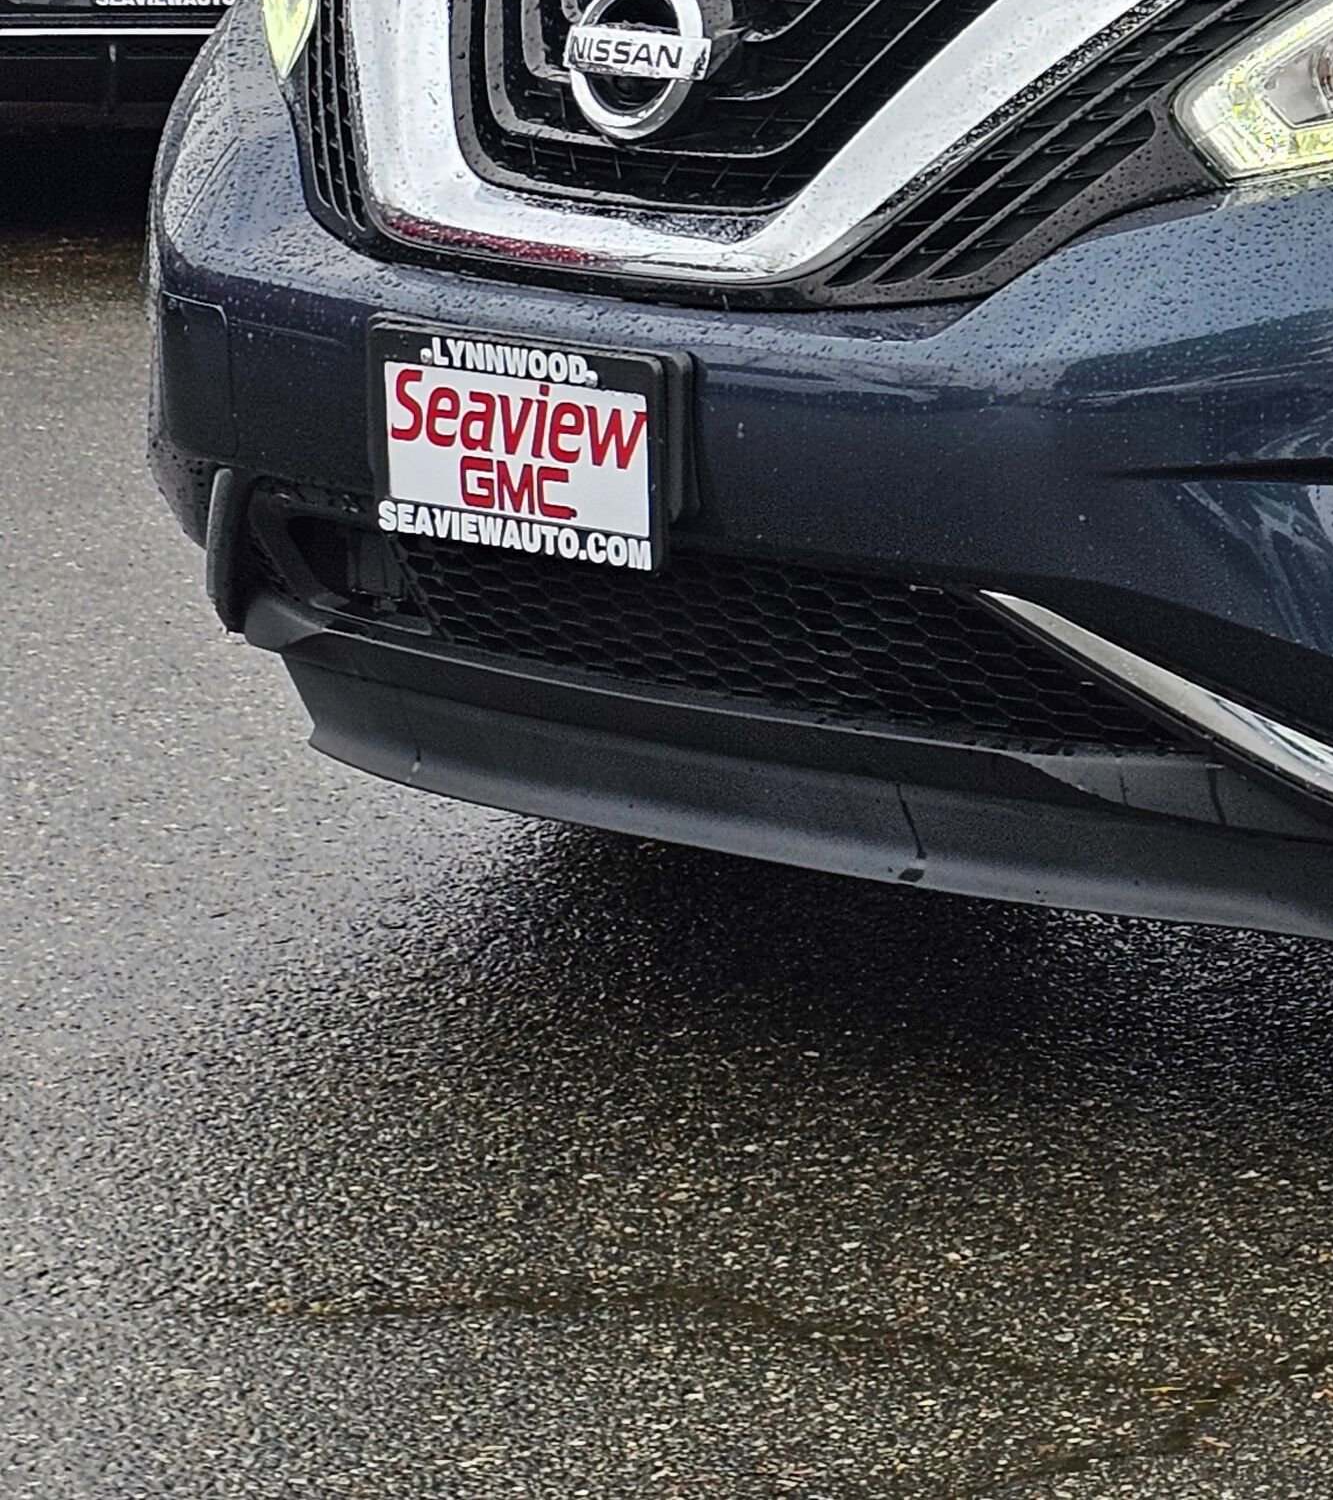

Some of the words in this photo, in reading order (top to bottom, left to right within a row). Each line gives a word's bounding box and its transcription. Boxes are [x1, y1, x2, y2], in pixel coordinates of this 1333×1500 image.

[568, 35, 684, 71] NISSAN
[431, 336, 589, 385] LYNNWOOD
[390, 367, 649, 470] Seaview
[459, 455, 578, 521] GMC
[377, 499, 653, 572] SEAVIEWAUTO.COM
